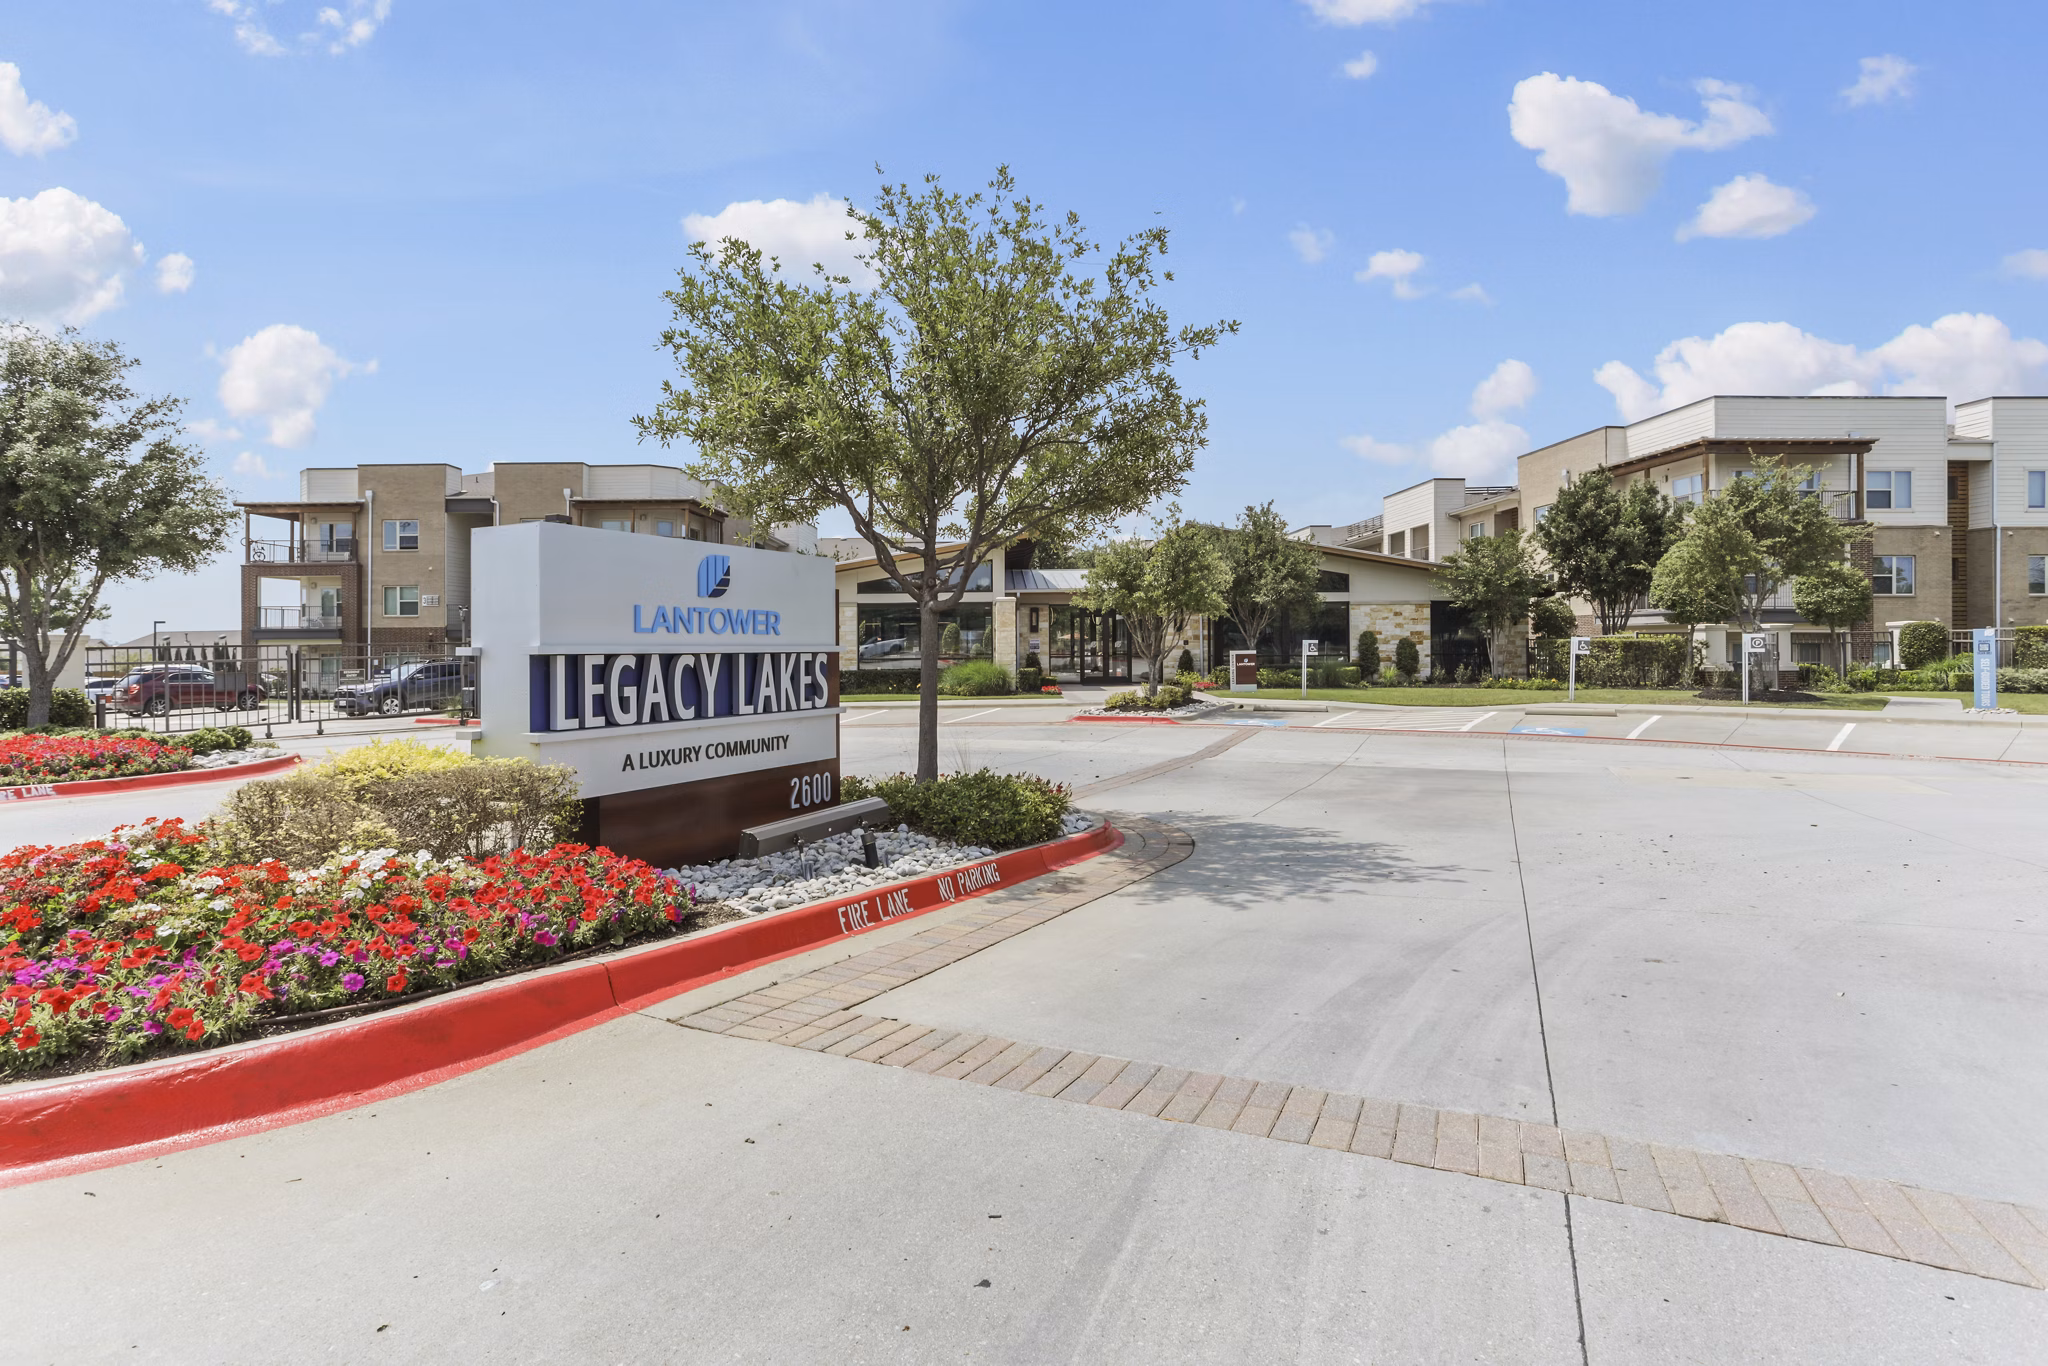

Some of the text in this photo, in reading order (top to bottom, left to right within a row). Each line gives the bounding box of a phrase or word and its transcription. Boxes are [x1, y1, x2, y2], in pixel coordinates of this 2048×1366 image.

[633, 604, 781, 636] LANTOWER
[1980, 658, 1990, 690] SELF-GUIDED
[551, 653, 828, 730] LEGACY LAKES
[1981, 690, 1990, 706] TOURS
[622, 735, 790, 772] A LUXURY COMMUNITY
[21, 785, 57, 798] LANE
[790, 771, 832, 809] 2600
[837, 862, 1001, 934] FIRE LANE NO PARKING
